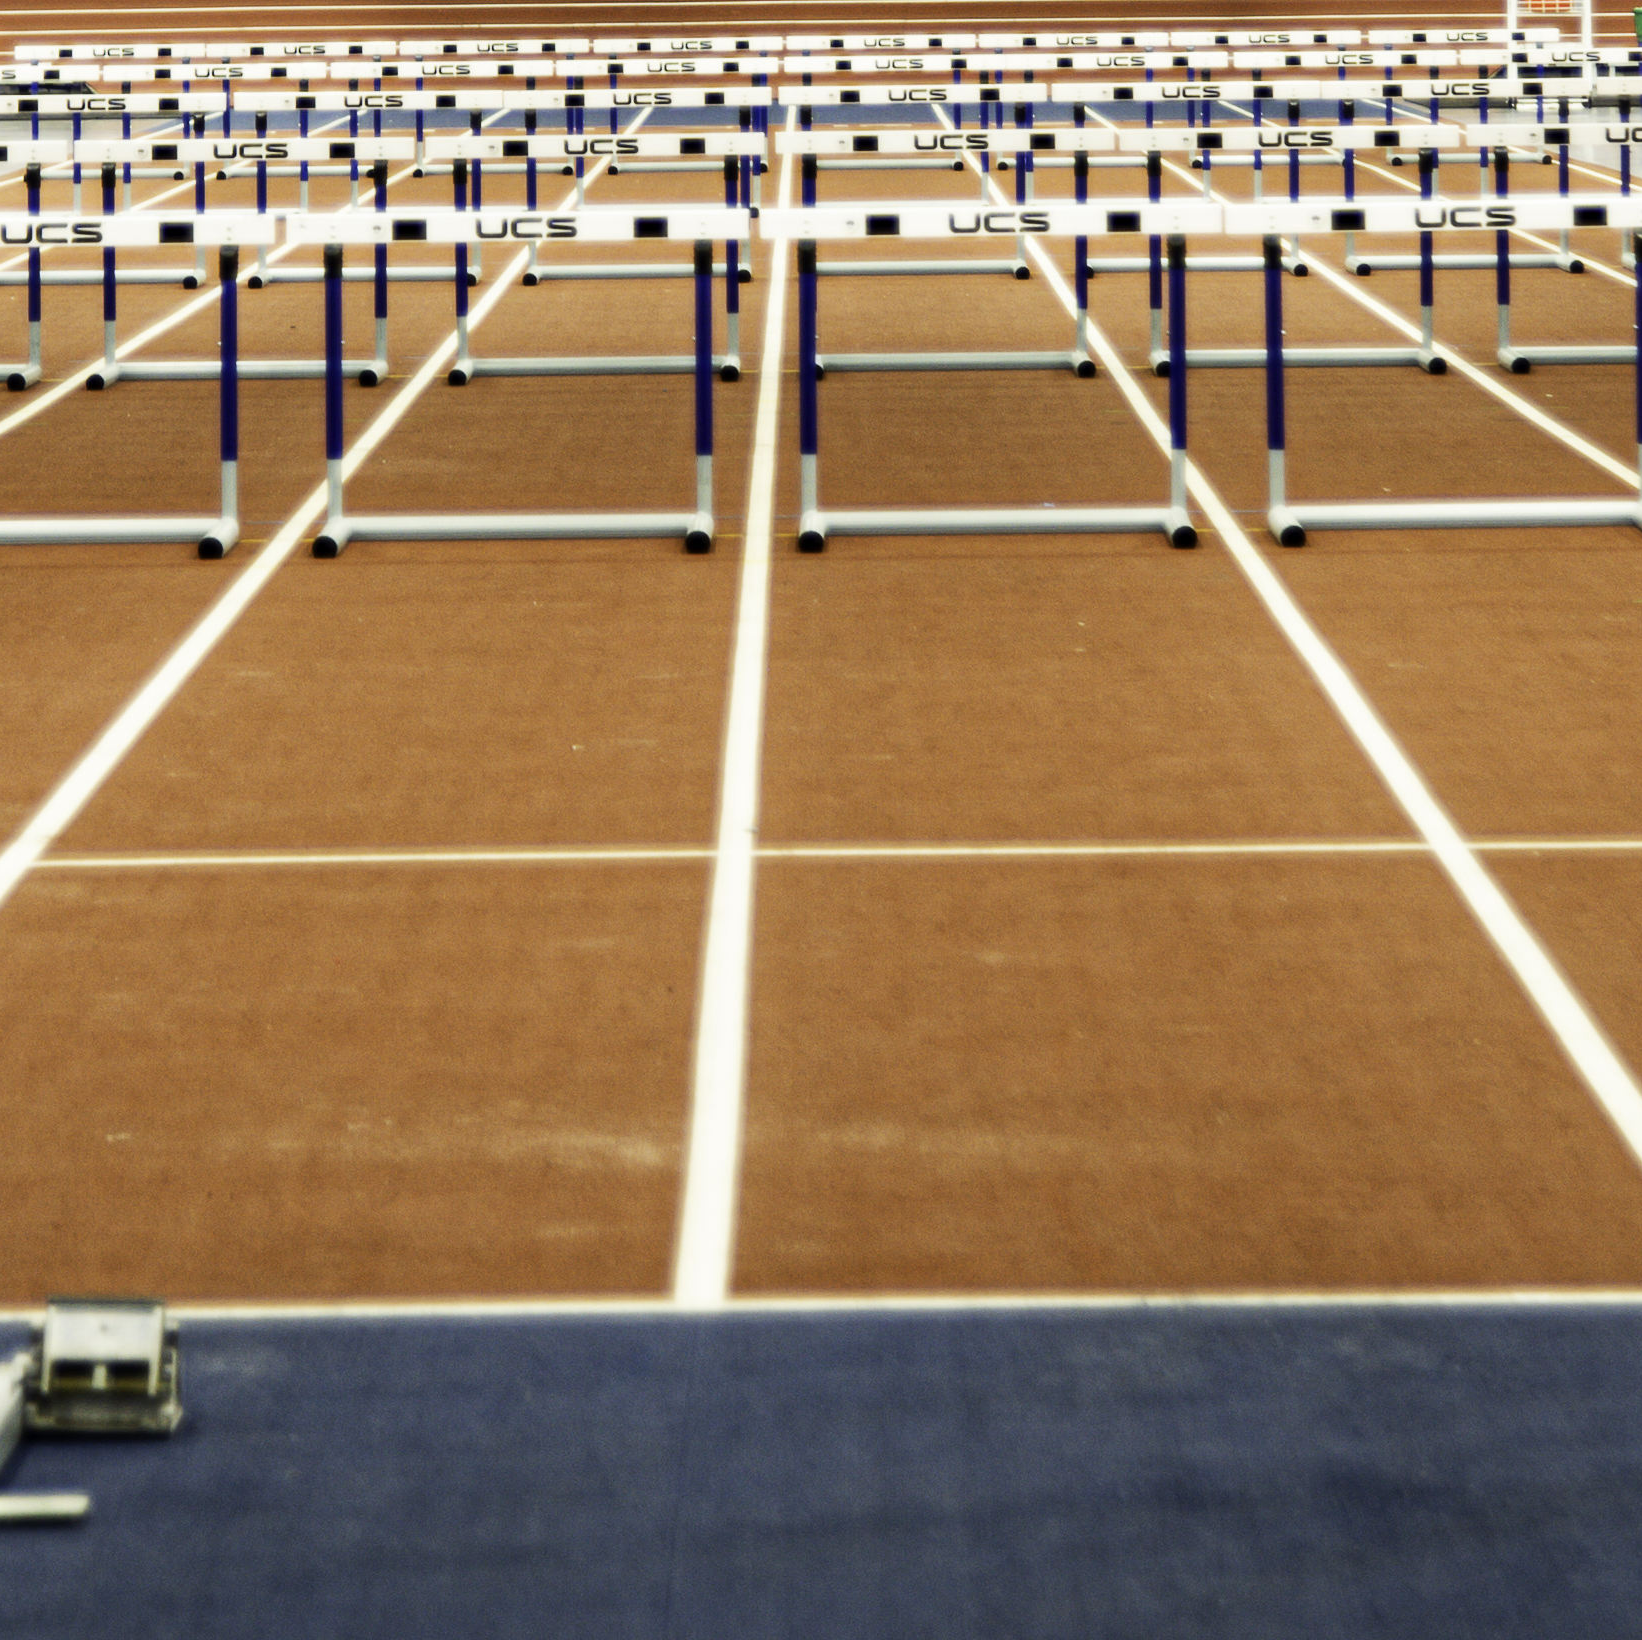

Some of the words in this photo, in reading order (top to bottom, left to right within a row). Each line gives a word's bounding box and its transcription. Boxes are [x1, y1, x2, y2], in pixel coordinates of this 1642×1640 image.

[863, 38, 905, 47] UCS
[1056, 36, 1098, 46] UCS
[1248, 34, 1290, 44] UCS
[1446, 32, 1488, 41] UCS
[283, 45, 326, 55] UCS
[477, 43, 519, 52] UCS
[670, 40, 713, 50] UCS
[92, 48, 135, 57] UCS
[1551, 51, 1601, 62] UCS
[874, 58, 924, 70] UCS
[1096, 56, 1146, 67] UCS
[1324, 54, 1374, 65] UCS
[194, 67, 244, 78] UCS
[422, 64, 471, 75] UCS
[647, 61, 696, 73] UCS
[888, 88, 947, 102] UCS
[1161, 85, 1220, 98] UCS
[1431, 83, 1490, 96] UCS
[67, 98, 126, 112] UCS
[344, 95, 403, 108] UCS
[613, 92, 672, 106] UCS
[914, 134, 988, 151] UCS
[1258, 131, 1333, 148] UCS
[213, 143, 289, 160] UCS
[563, 139, 639, 156] UCS
[948, 212, 1051, 234] UCS
[1415, 207, 1516, 229] UCS
[0, 223, 103, 245] UCS
[476, 217, 577, 239] UCS
